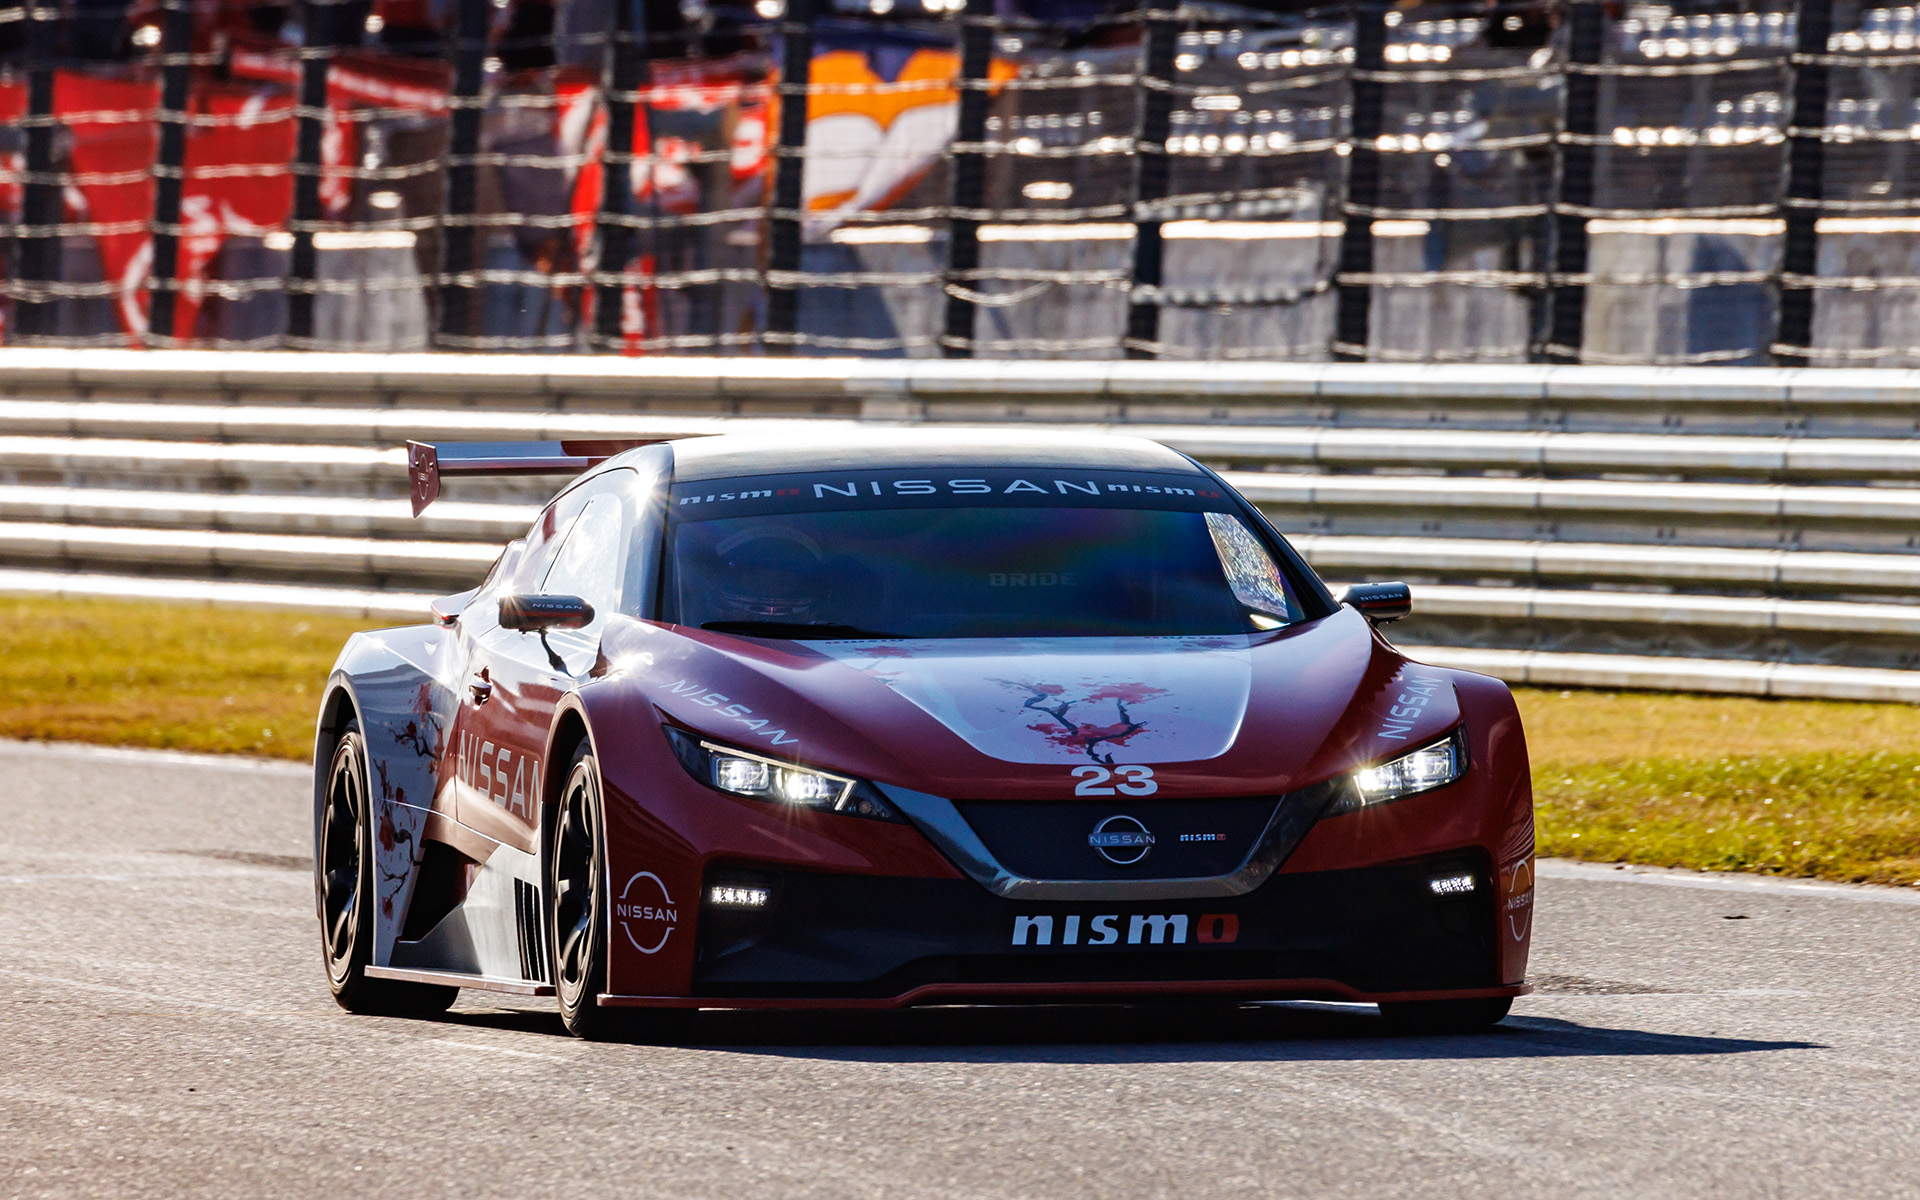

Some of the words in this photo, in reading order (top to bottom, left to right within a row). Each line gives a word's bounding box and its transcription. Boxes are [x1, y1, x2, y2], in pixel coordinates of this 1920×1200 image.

[812, 479, 1101, 499] NISSAN
[988, 573, 1077, 587] BRIDE
[658, 679, 800, 746] NISSAN
[1377, 674, 1444, 740] NISSAN
[1070, 764, 1159, 797] 23
[1090, 834, 1156, 845] NISSAN
[1179, 833, 1227, 842] nismo
[616, 903, 678, 923] NISSAN
[1011, 913, 1240, 946] nismo
